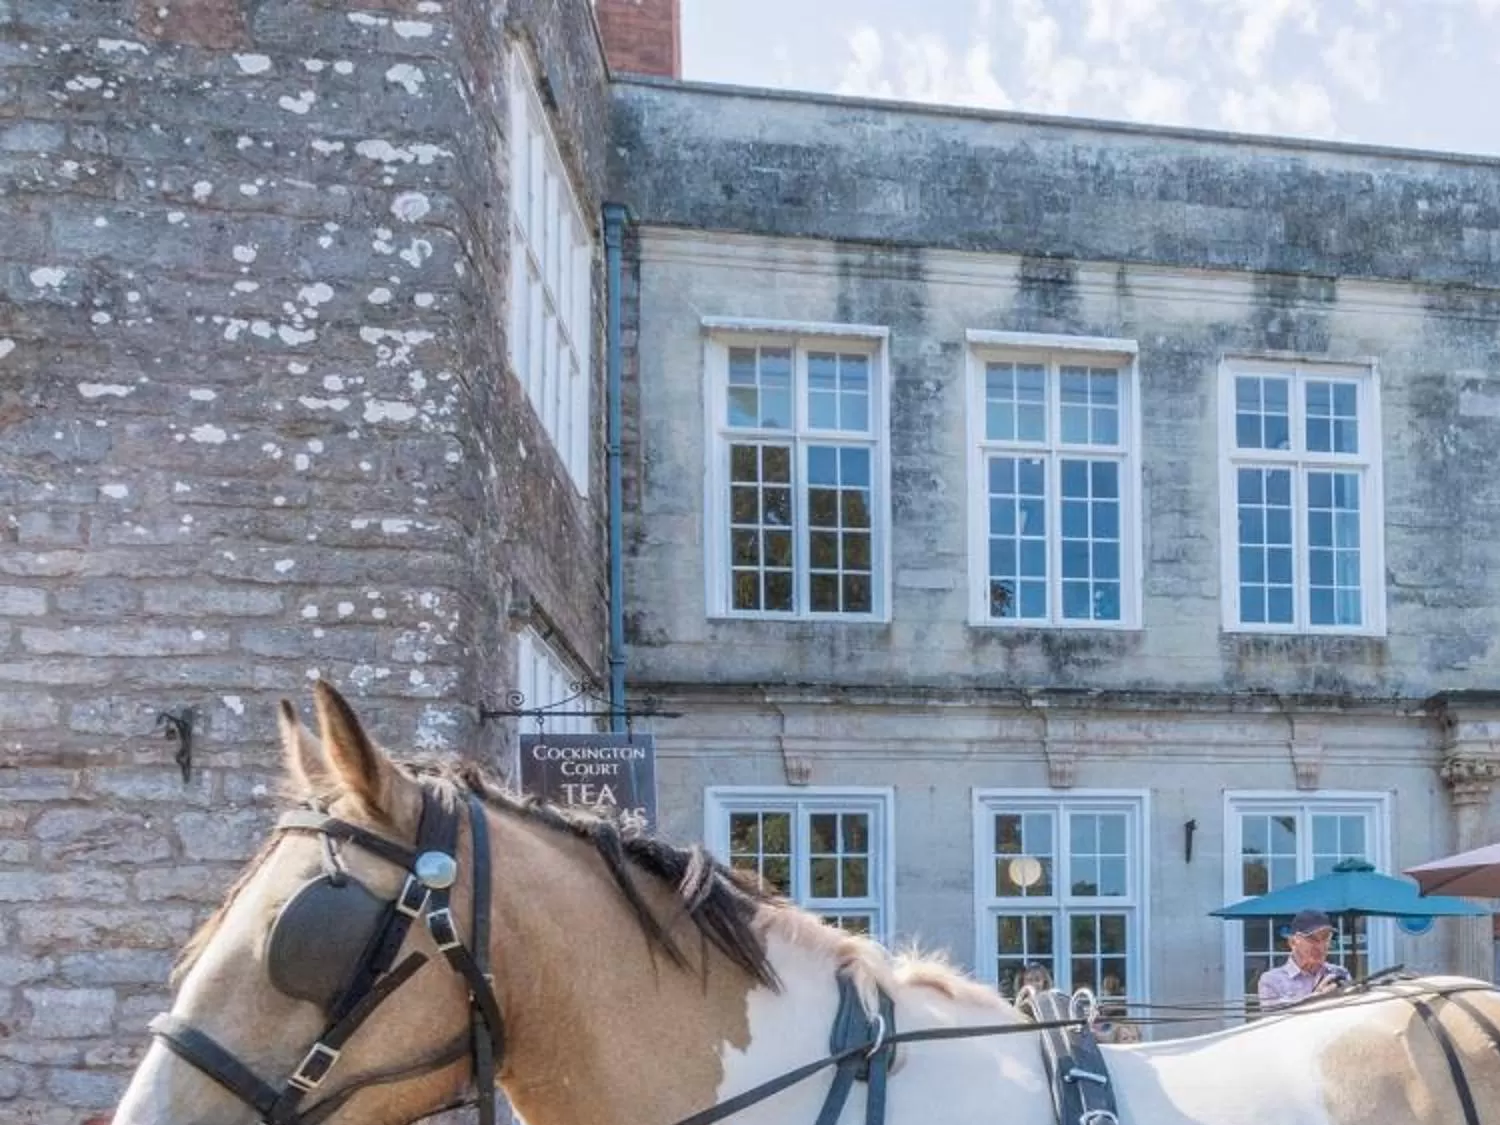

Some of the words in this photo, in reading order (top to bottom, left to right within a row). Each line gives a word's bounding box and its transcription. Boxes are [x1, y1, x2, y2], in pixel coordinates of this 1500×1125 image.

[532, 745, 646, 761] COCKINGTON
[561, 761, 621, 776] COURT
[561, 783, 618, 805] TEA
